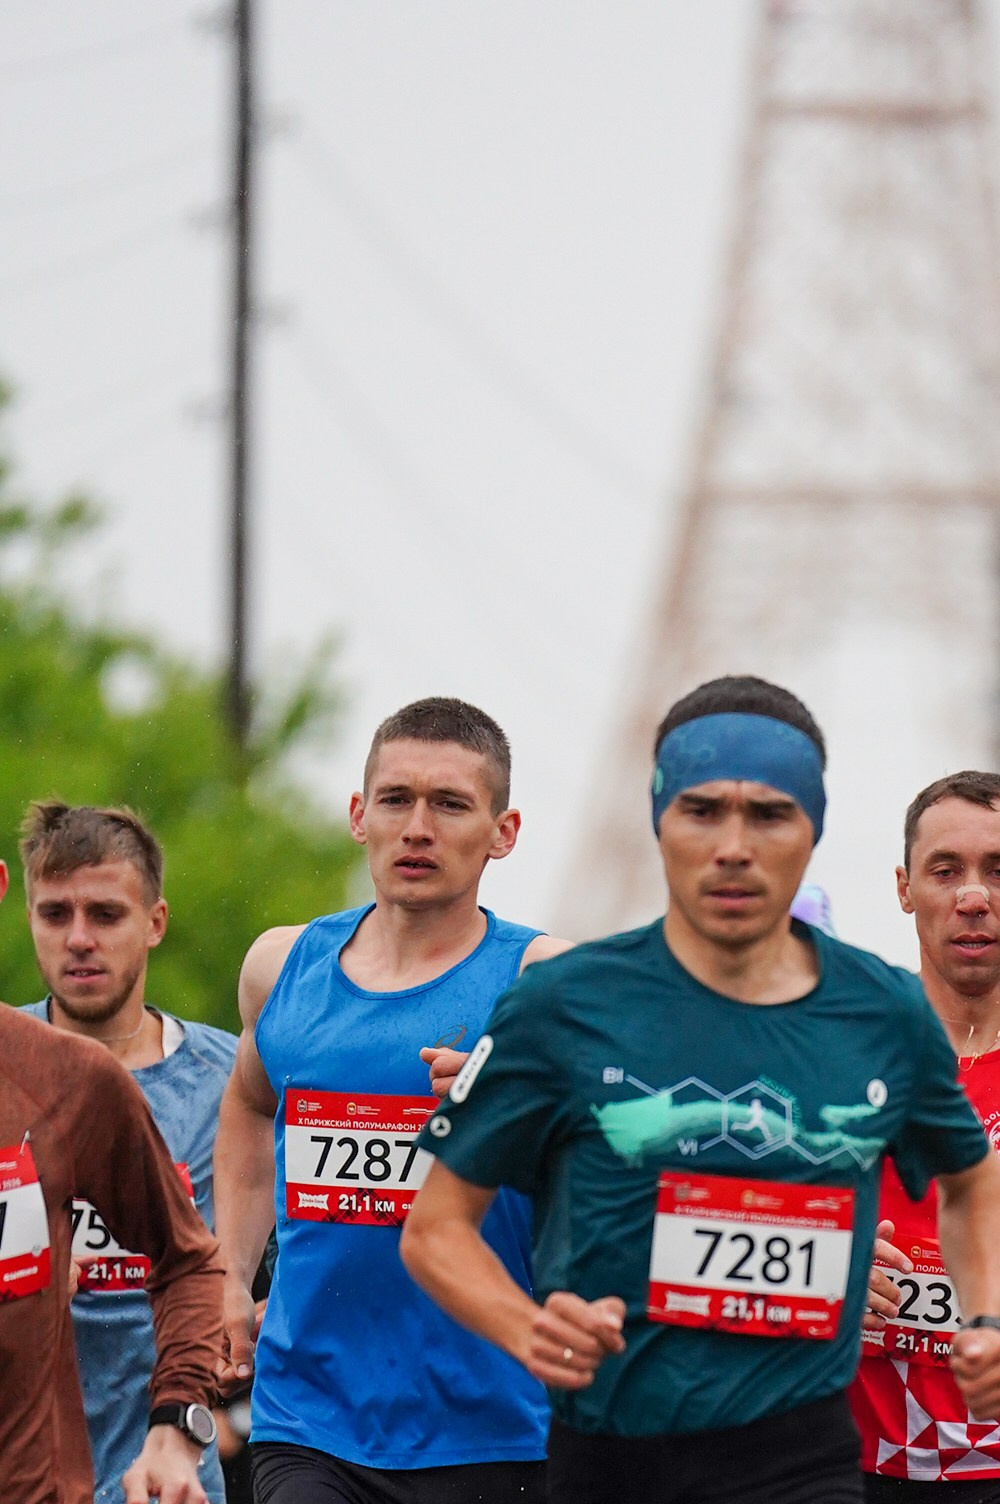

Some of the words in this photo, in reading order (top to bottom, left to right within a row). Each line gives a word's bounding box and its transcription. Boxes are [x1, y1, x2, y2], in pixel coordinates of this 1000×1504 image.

[304, 1118, 352, 1128] ПАРИЖСКИЙ
[353, 1121, 416, 1132] ПОЛУМАРАФОН
[310, 1135, 420, 1183] 7287
[338, 1193, 371, 1213] 21,1
[694, 1228, 816, 1287] 7281
[87, 1263, 123, 1281] 21,1
[721, 1295, 765, 1322] 21,1
[896, 1332, 928, 1354] 21,1
